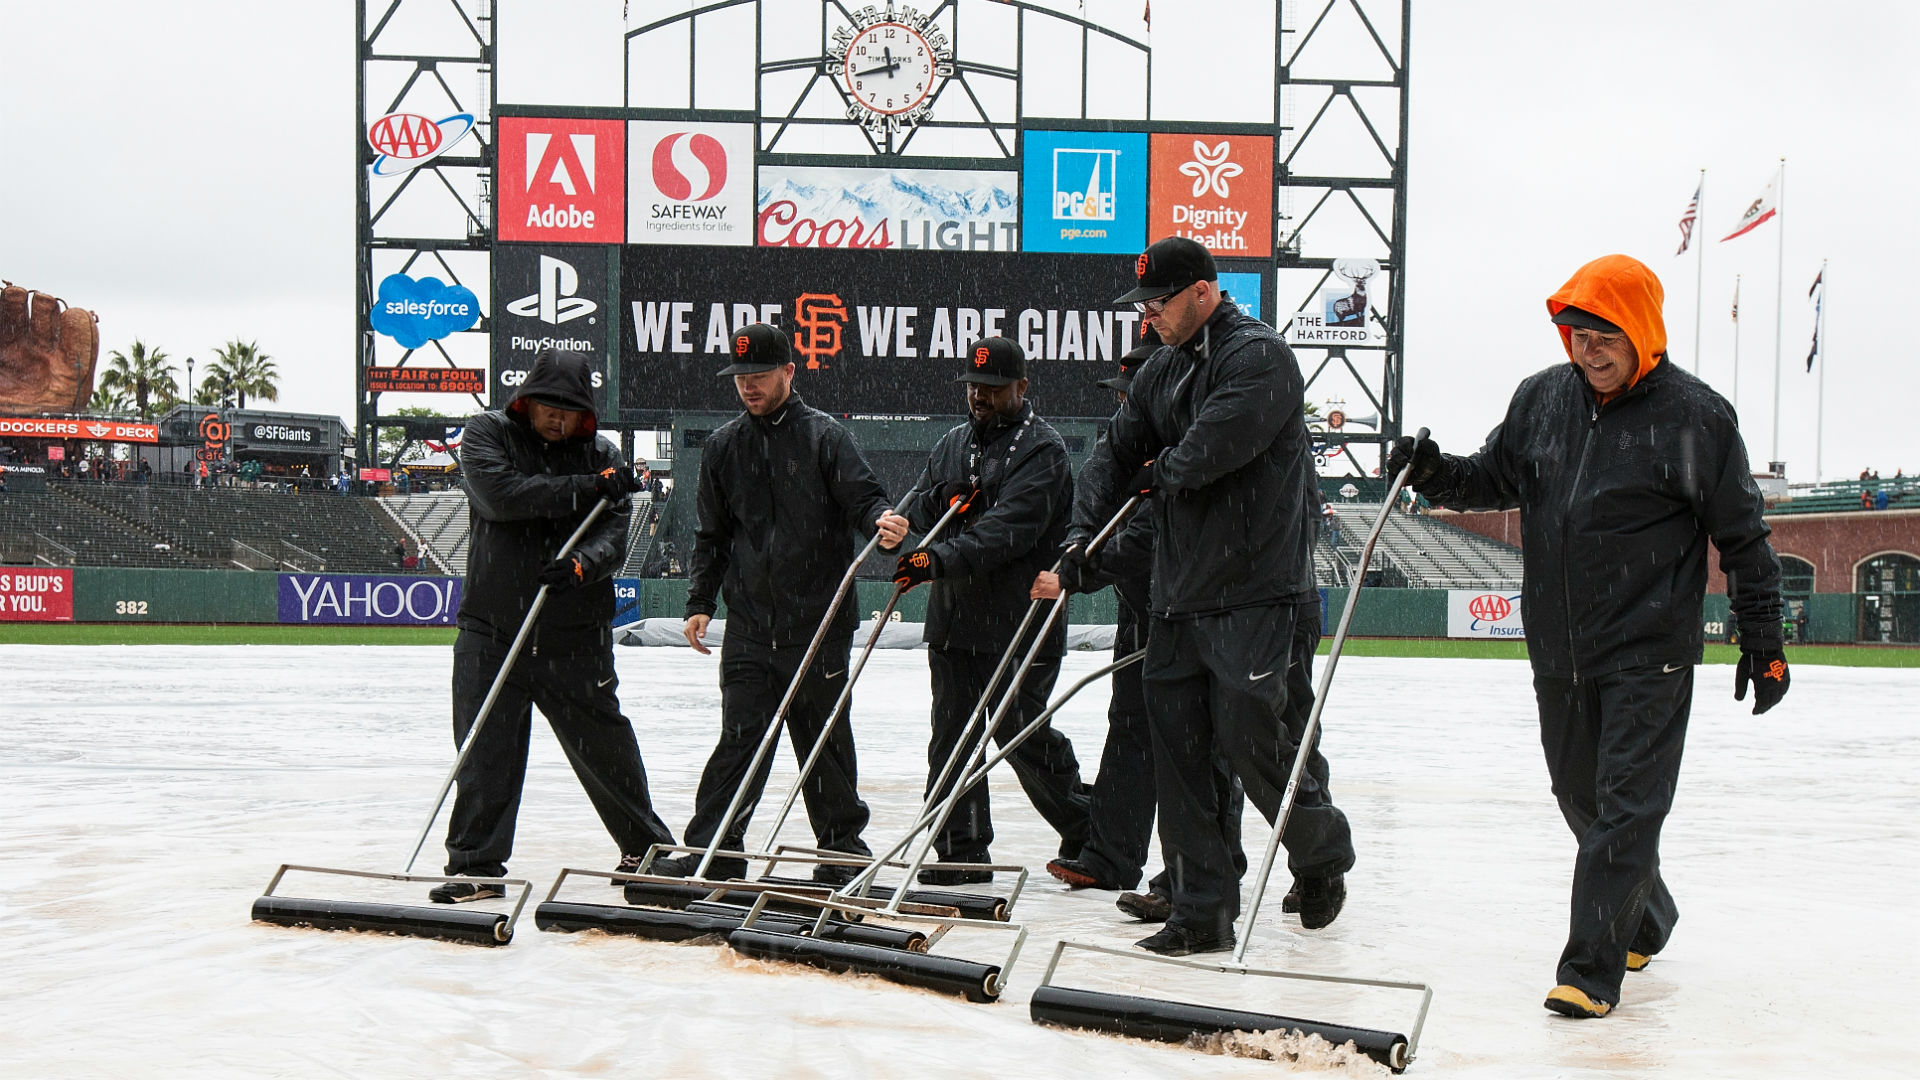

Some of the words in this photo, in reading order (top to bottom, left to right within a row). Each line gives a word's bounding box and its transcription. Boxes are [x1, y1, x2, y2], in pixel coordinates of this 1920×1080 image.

[869, 34, 877, 43] 11
[885, 29, 895, 38] 12
[906, 34, 910, 43] 1
[825, 26, 853, 75] SAN
[851, 3, 954, 77] FRANCISCO
[856, 46, 866, 55] 10
[918, 47, 923, 56] 2
[851, 64, 856, 72] 9
[923, 65, 928, 73] 3
[856, 81, 862, 90] 8
[916, 82, 922, 91] 4
[870, 93, 876, 102] 7
[887, 99, 892, 107] 6
[904, 94, 909, 103] 5
[846, 102, 934, 134] GIANTS
[378, 116, 437, 158] AAA
[1056, 191, 1114, 217] PG&E
[526, 204, 595, 229] Adobe
[651, 204, 727, 219] SAFEWAY
[1173, 205, 1248, 230] Dignity
[646, 221, 700, 232] Ingredients
[702, 222, 715, 231] for
[718, 222, 733, 231] life
[757, 200, 893, 248] Coors
[901, 219, 1017, 250] LIGHT
[1060, 229, 1107, 240] pge.com
[385, 299, 469, 320] salesforce
[1298, 317, 1322, 327] THE
[632, 301, 693, 353] WE
[856, 306, 917, 357] WE
[1018, 308, 1139, 362] GIANT
[1297, 330, 1367, 341] HARTFORD
[391, 370, 428, 380] FAIR
[370, 382, 387, 390] ISSUE
[388, 382, 395, 390] &
[396, 382, 425, 390] LOCATION
[440, 381, 483, 391] 69050
[0, 422, 78, 434] DOCKERS
[115, 426, 155, 439] DECK
[254, 425, 311, 442] @SFGiants
[15, 575, 63, 592] BUD'S
[10, 595, 46, 612] YOU.
[289, 576, 453, 622] YAHOO!
[115, 600, 148, 615] 382
[1473, 595, 1507, 620] AAA
[871, 611, 902, 621] 39
[1703, 622, 1724, 635] 421
